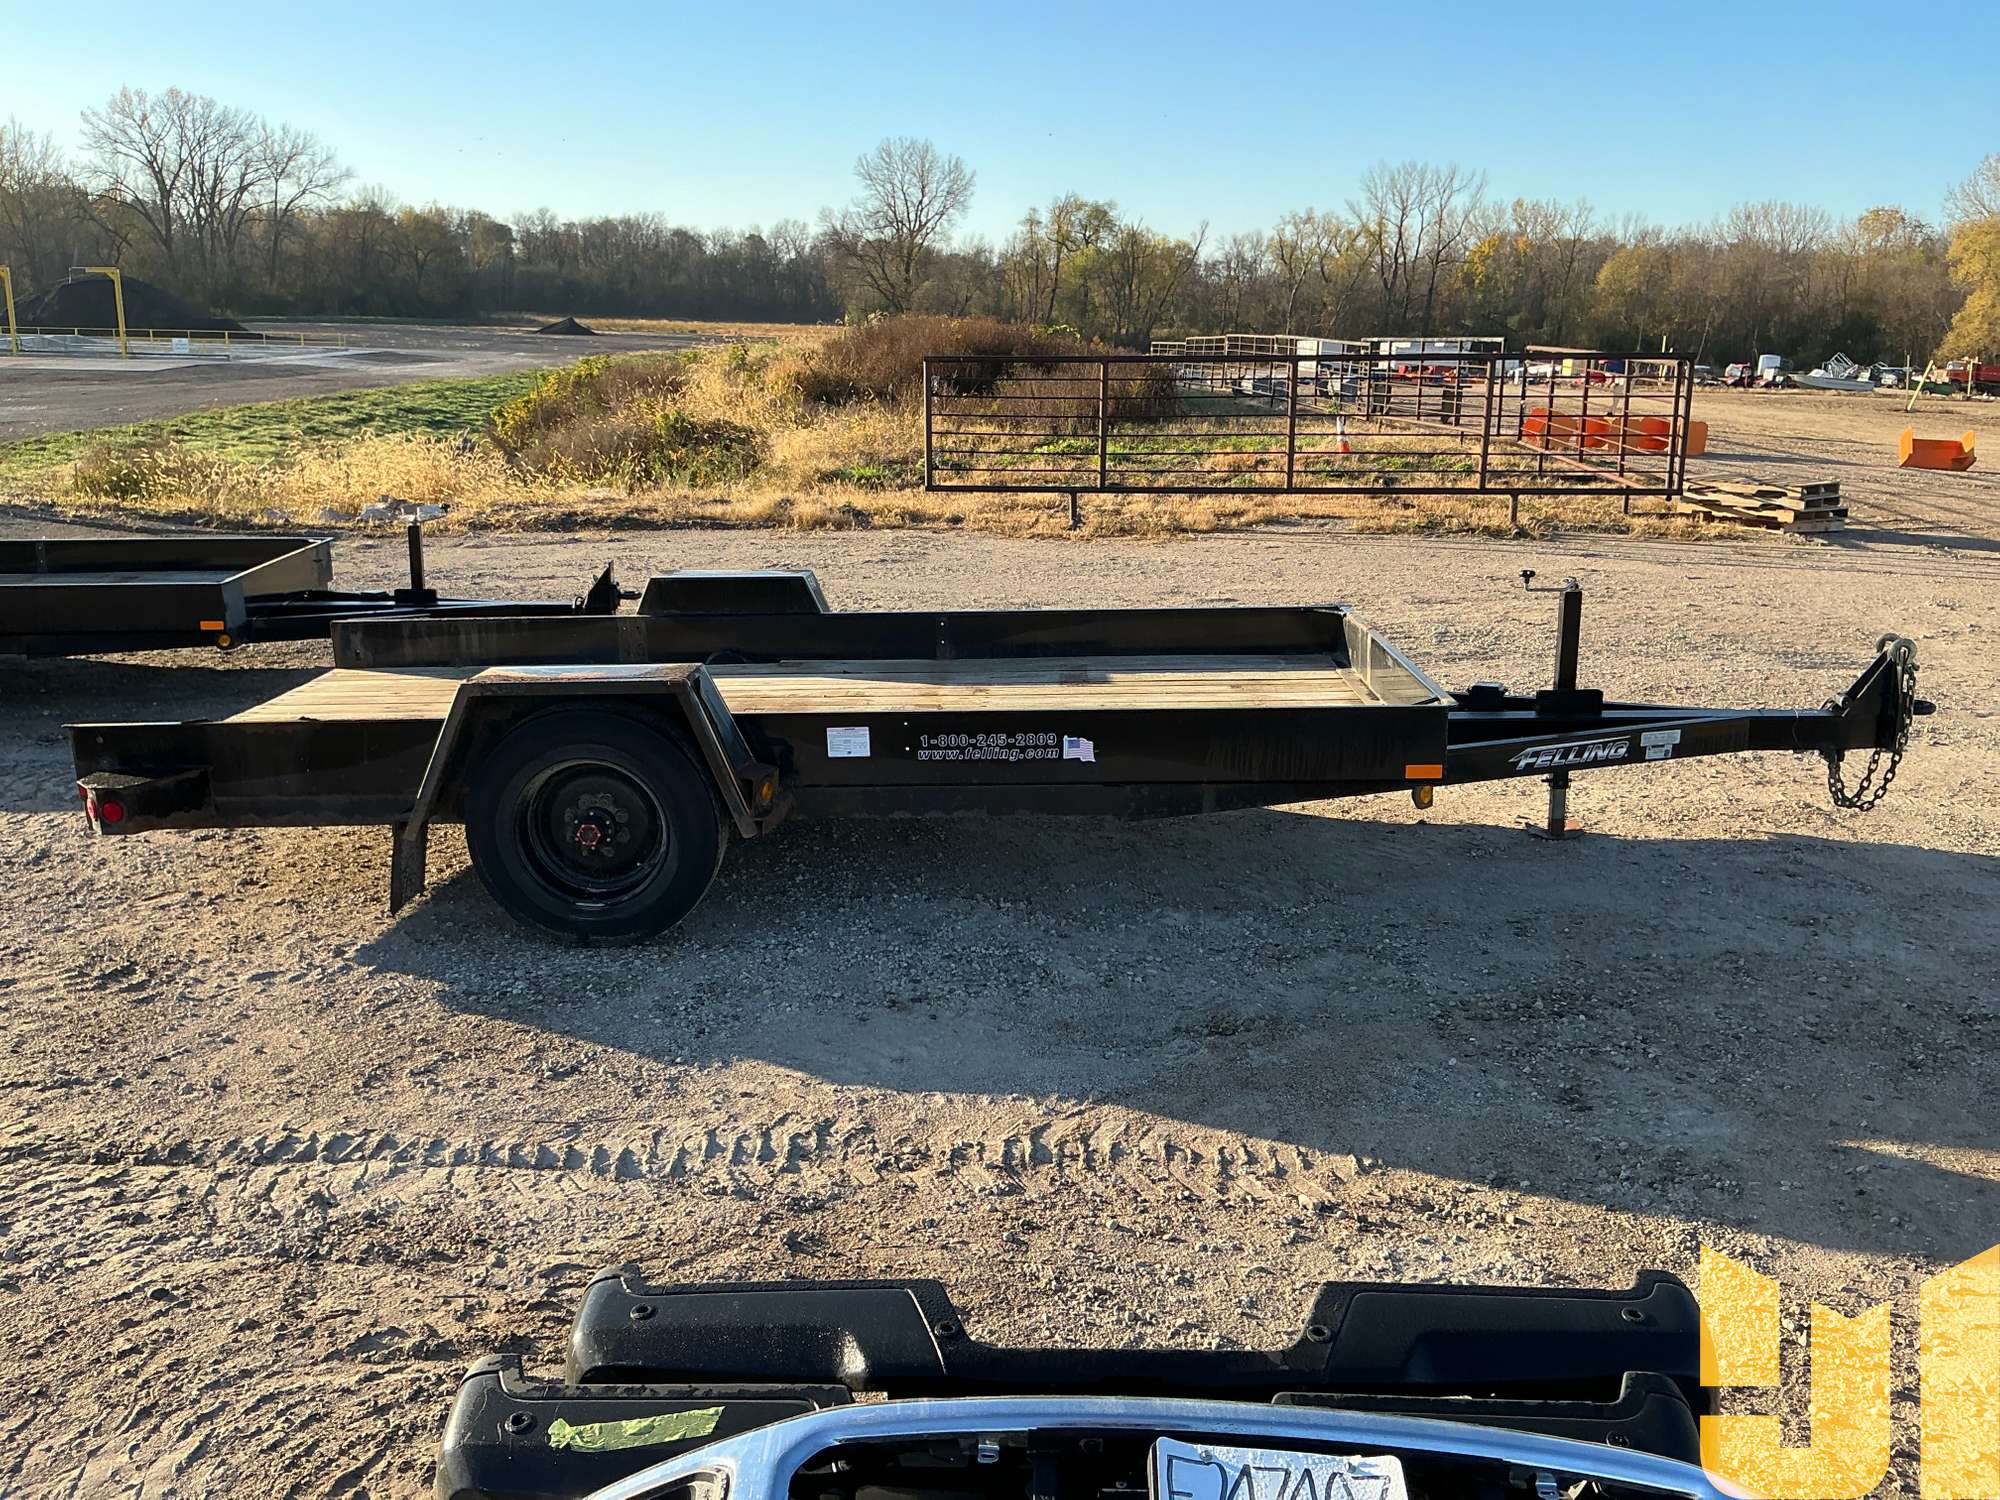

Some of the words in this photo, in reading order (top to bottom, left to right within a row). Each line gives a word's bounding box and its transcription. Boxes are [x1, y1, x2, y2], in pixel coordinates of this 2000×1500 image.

[920, 733, 1057, 748] 1-800-245-2809
[917, 746, 1060, 762] www.felling.com
[1511, 739, 1630, 771] FELLING
